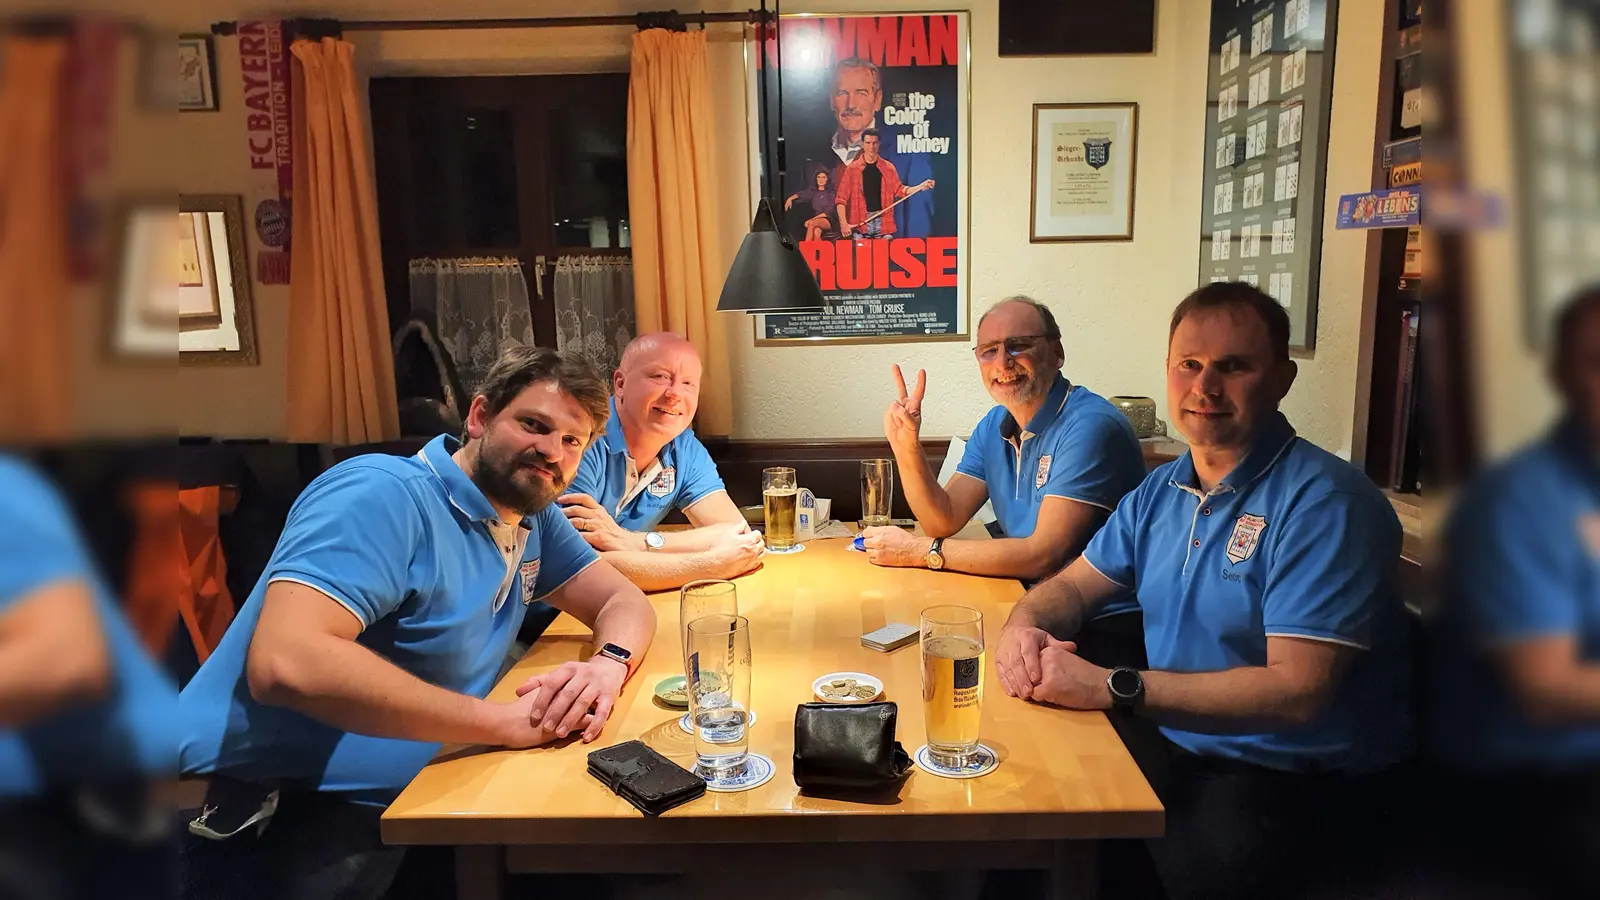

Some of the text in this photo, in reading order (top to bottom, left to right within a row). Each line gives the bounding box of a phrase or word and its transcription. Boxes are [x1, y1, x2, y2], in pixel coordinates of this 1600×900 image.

[239, 21, 273, 169] FC BAYERN
[908, 92, 935, 110] the
[273, 82, 291, 167] TRADITION
[884, 106, 927, 125] Color
[913, 120, 930, 139] of
[897, 134, 950, 154] Money
[799, 237, 957, 291] RUISE
[820, 303, 905, 315] AUL NEWMAN TOM CRUISE
